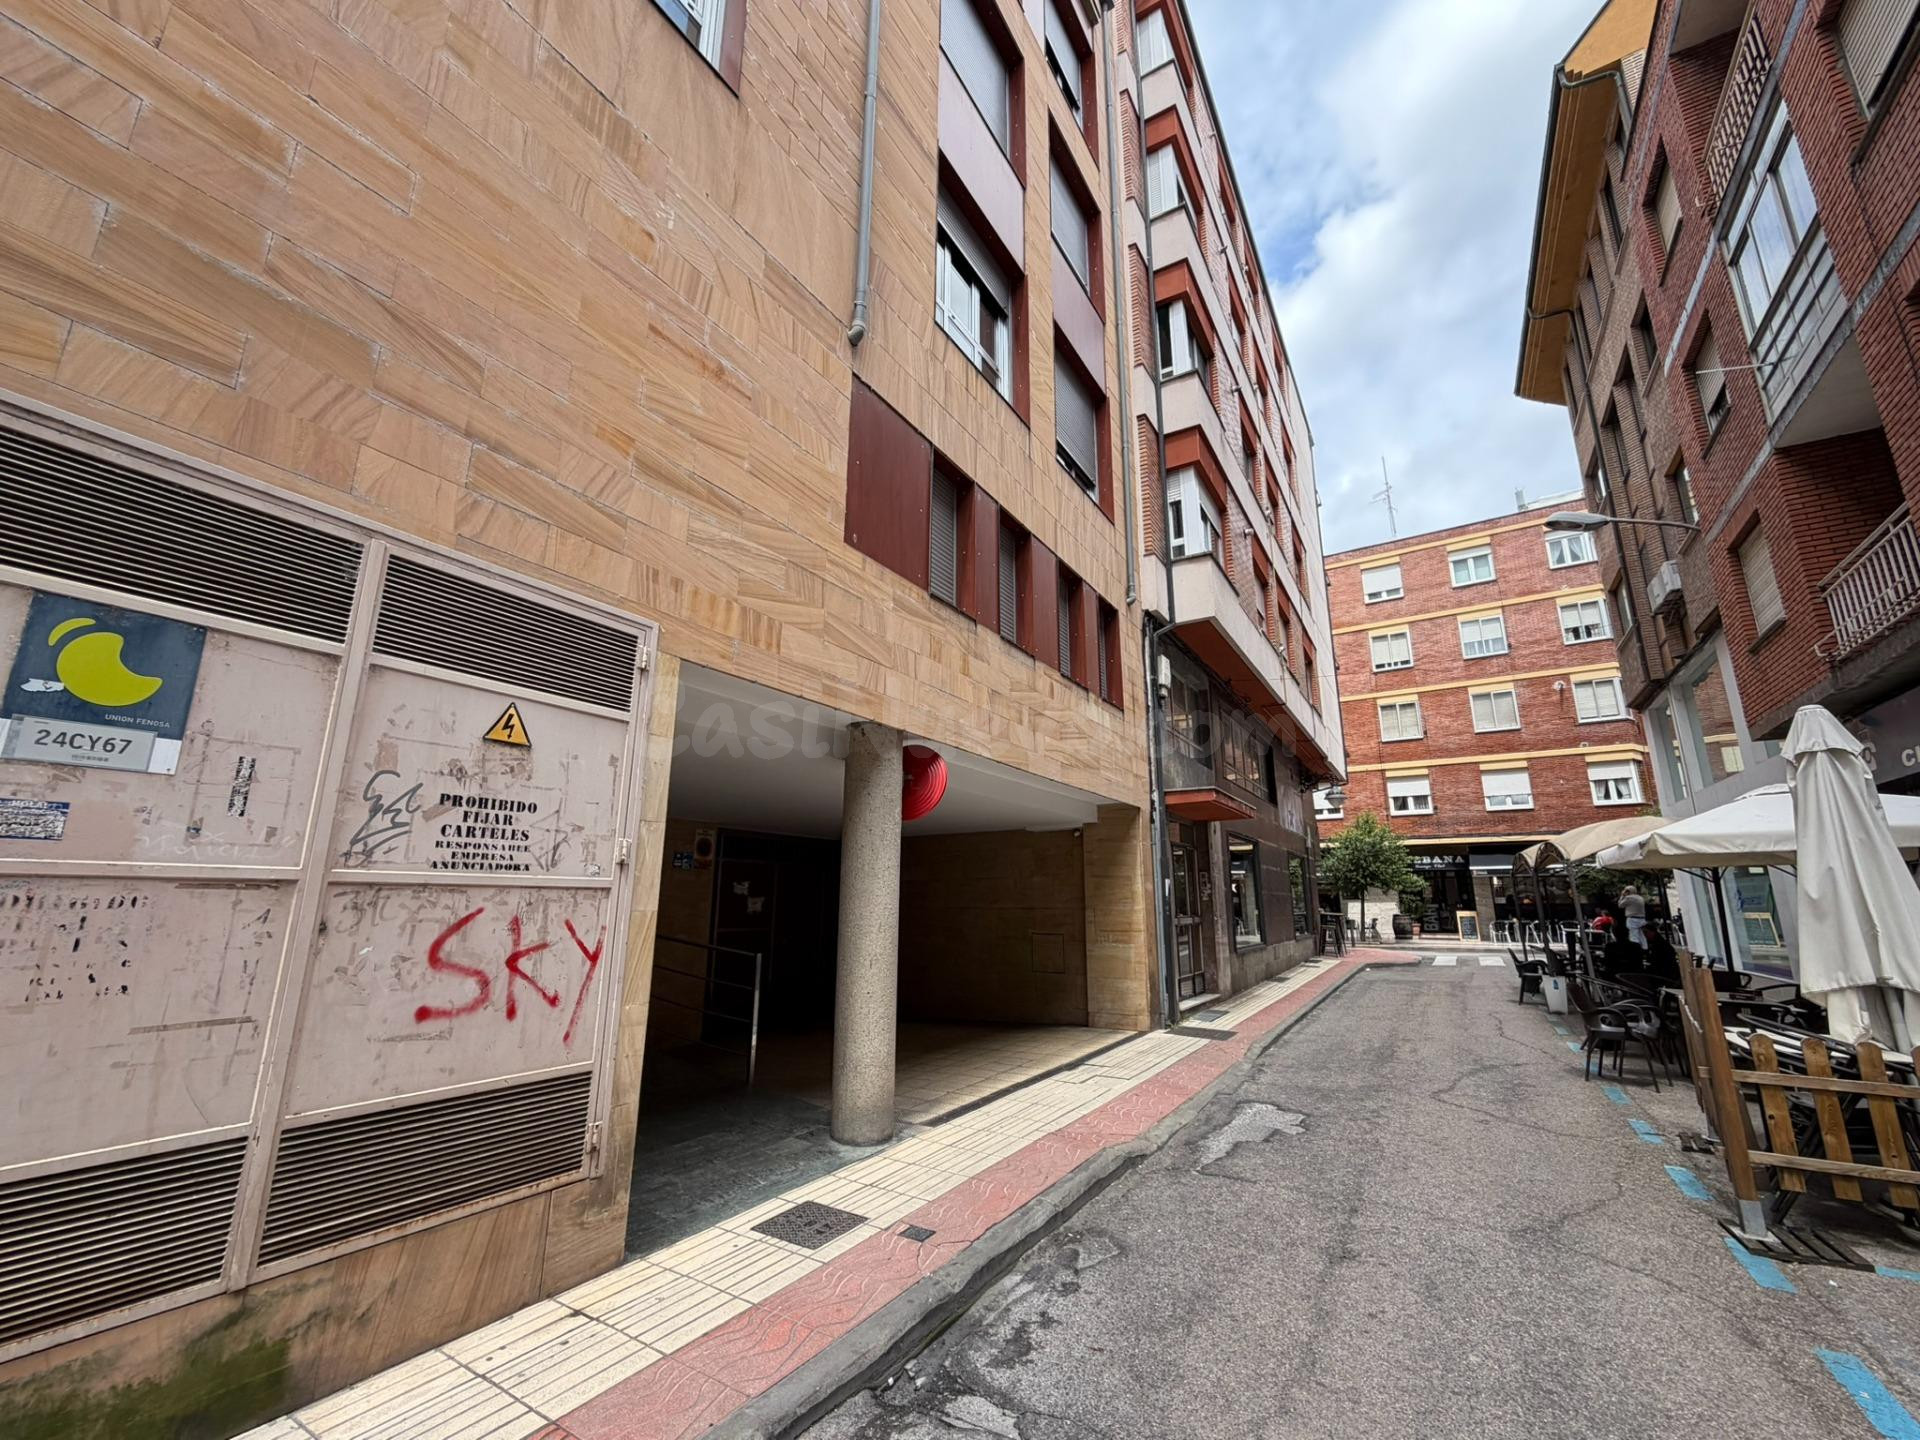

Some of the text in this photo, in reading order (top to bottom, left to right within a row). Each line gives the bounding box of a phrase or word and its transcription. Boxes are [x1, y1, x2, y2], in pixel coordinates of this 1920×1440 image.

[104, 713, 171, 729] UNION FENOSA
[33, 729, 133, 755] 24CY67
[438, 792, 539, 815] PROHIBIDO
[462, 810, 514, 826] FIJAR
[440, 823, 531, 842] CARTELES
[434, 840, 532, 853] RESPONSABLE
[450, 851, 515, 862] EMPRESA
[428, 860, 532, 872] ANUNCIADORA
[413, 906, 607, 1047] SKY
